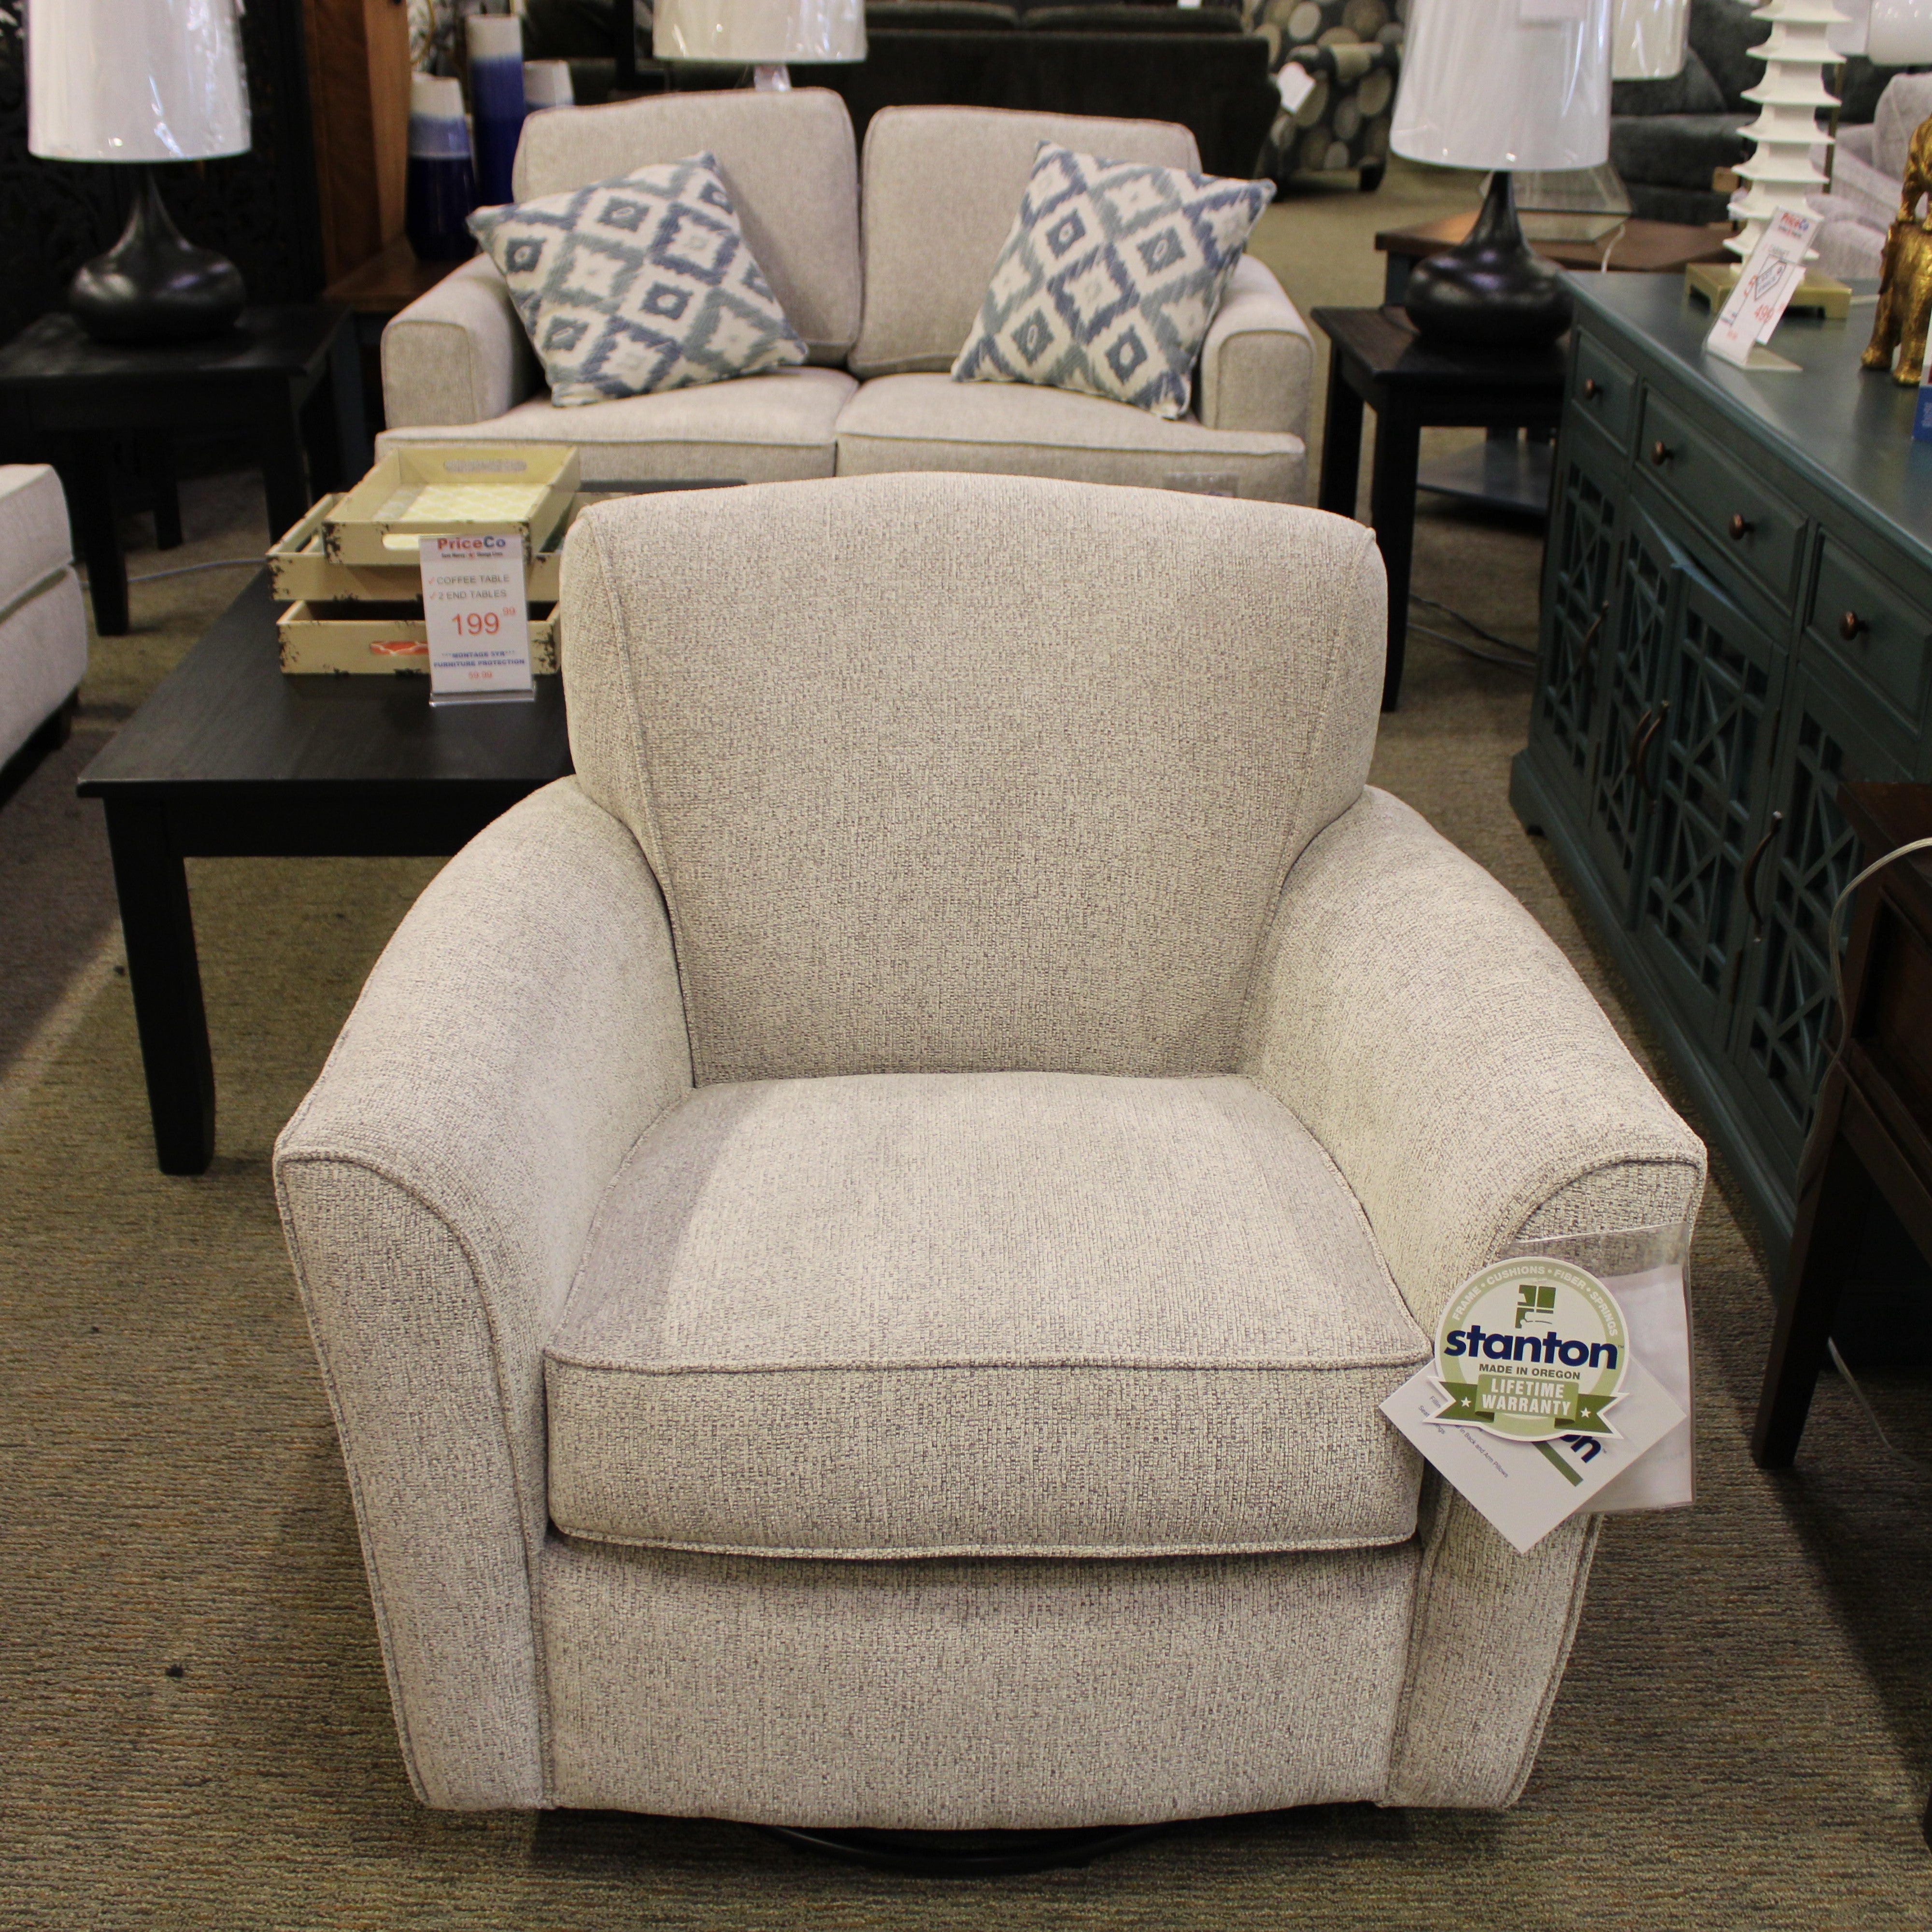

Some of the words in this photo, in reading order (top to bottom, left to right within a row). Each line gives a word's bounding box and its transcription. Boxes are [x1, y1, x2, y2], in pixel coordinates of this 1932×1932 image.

[1754, 304, 1775, 324] 499
[437, 535, 506, 550] PriceCo
[437, 575, 476, 584] COFFEE
[446, 591, 466, 599] END
[470, 589, 507, 598] TABLES
[452, 612, 499, 636] 199
[502, 607, 515, 615] 99
[1452, 1286, 1482, 1321] FRAME
[1487, 1266, 1545, 1285] CUSHIONS
[1554, 1269, 1587, 1290] FIBER
[1590, 1292, 1618, 1336] SPRINGS
[1444, 1325, 1618, 1370] stanton
[1479, 1363, 1513, 1375] MADE
[1516, 1367, 1528, 1376] IN
[1532, 1368, 1580, 1380] OREGON
[1491, 1378, 1564, 1398] LIFETIME
[1418, 1405, 1430, 1417] Seat
[1482, 1393, 1571, 1416] WARRANTY
[1429, 1395, 1441, 1408] Fillin
[1464, 1433, 1477, 1445] Back
[1475, 1444, 1485, 1454] and
[1483, 1452, 1494, 1463] Arm
[1492, 1462, 1509, 1478] Pillows
